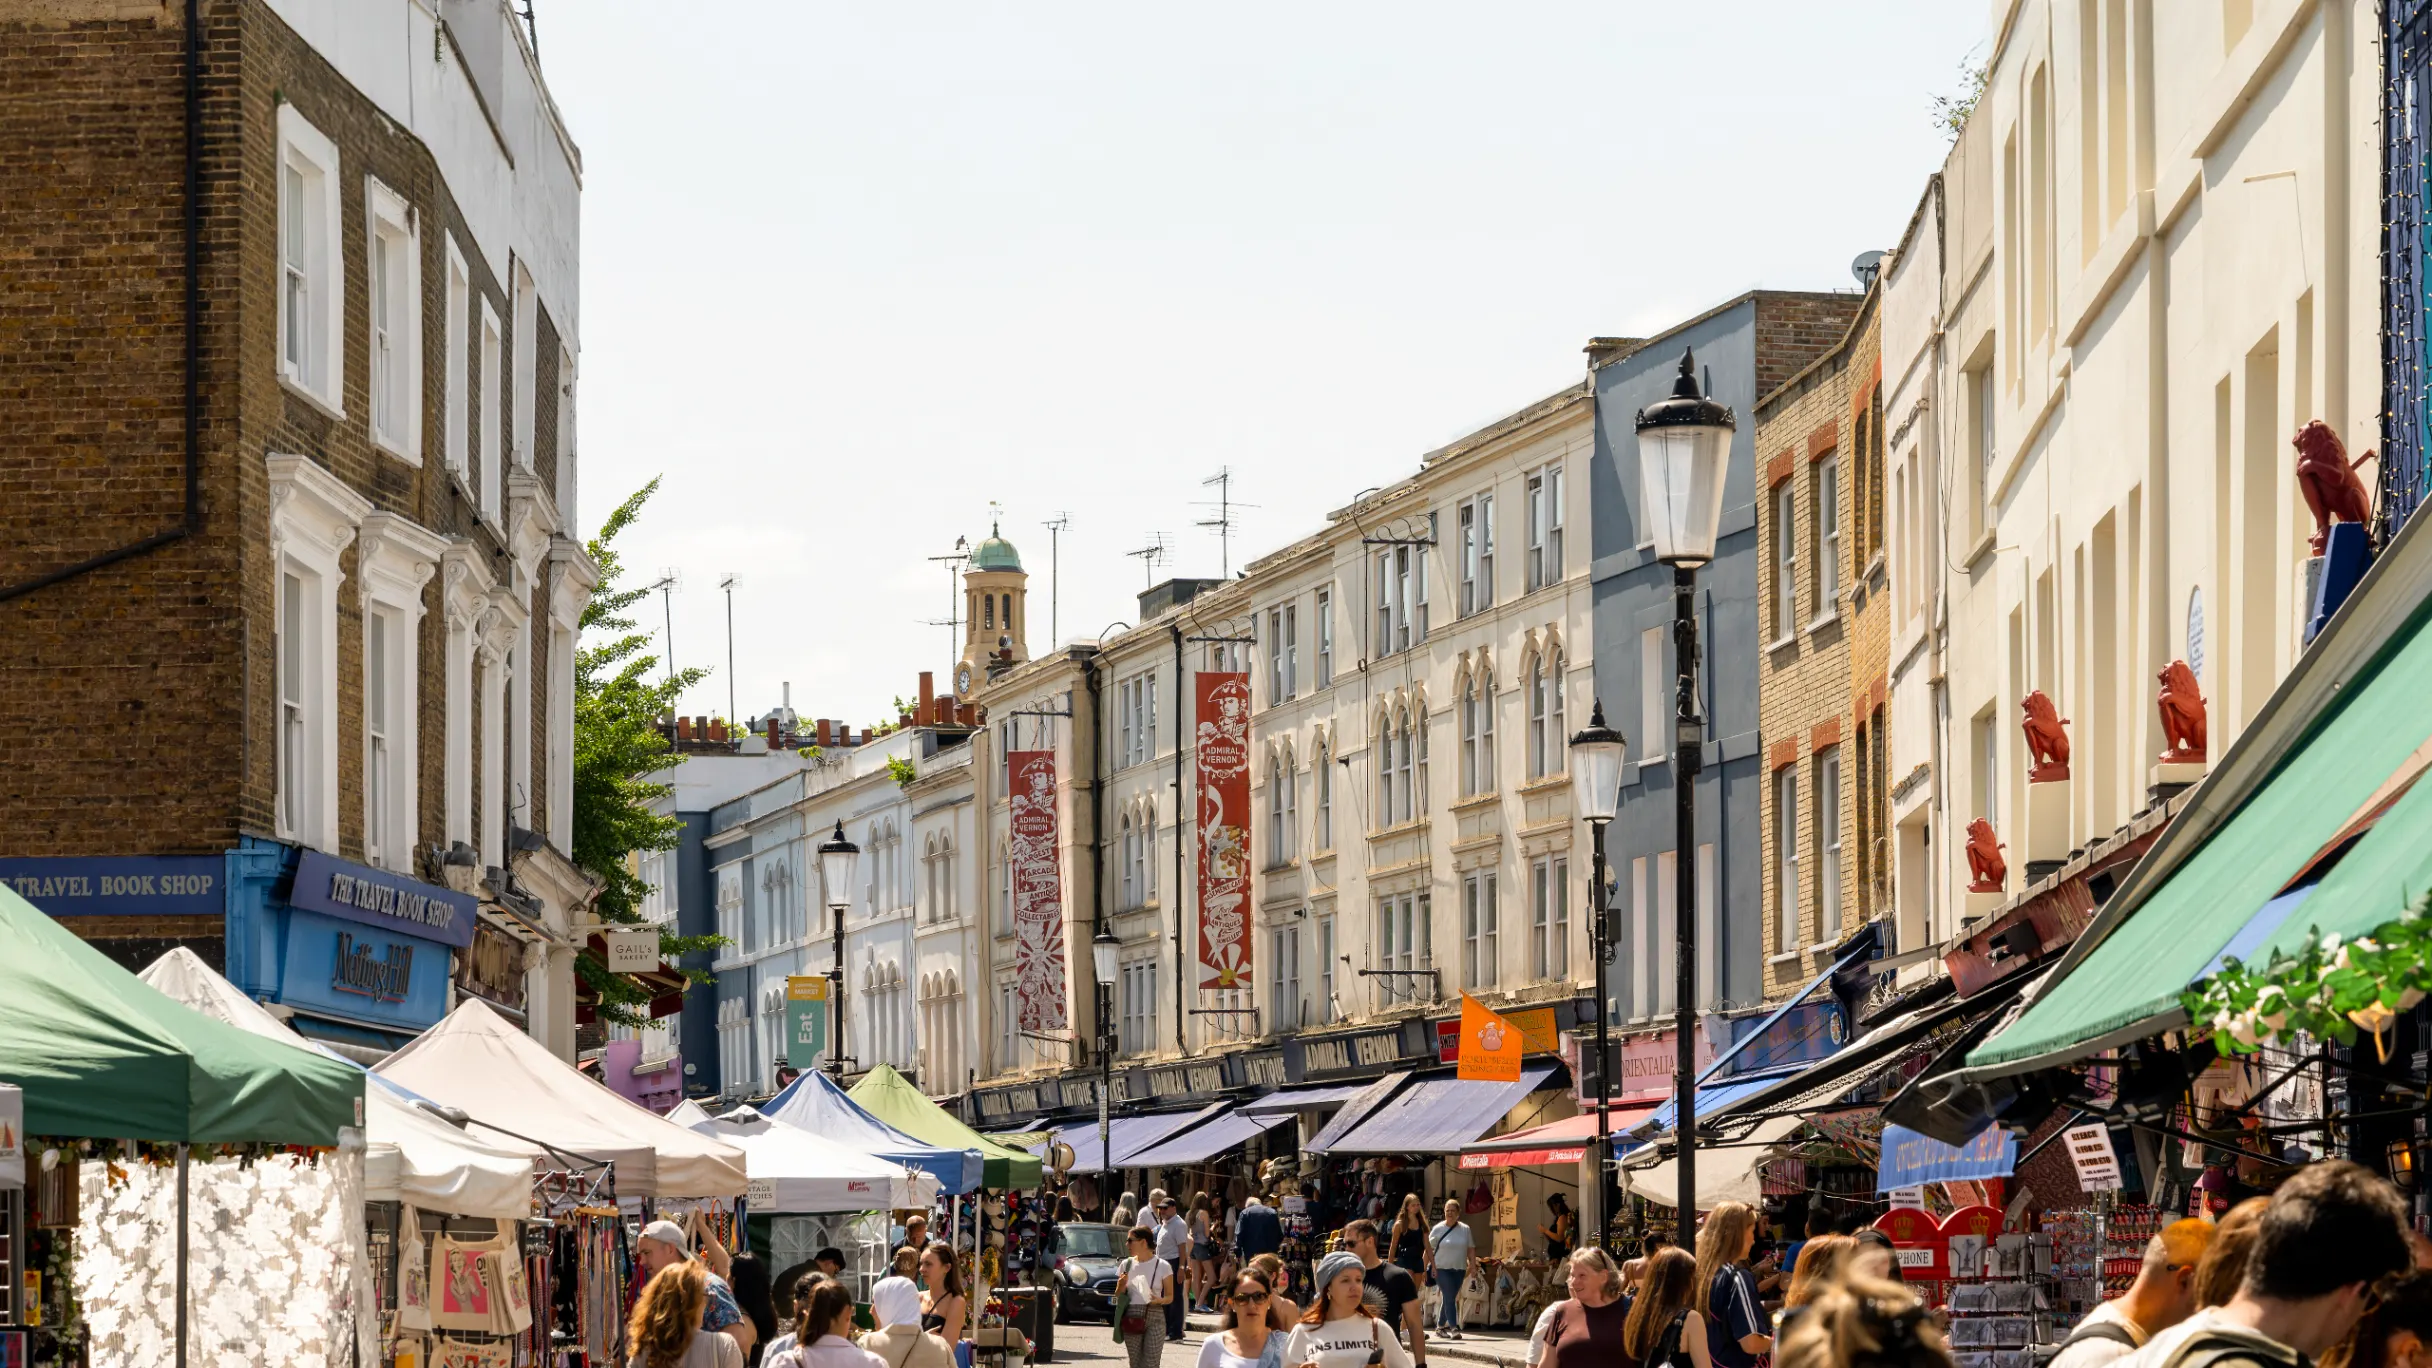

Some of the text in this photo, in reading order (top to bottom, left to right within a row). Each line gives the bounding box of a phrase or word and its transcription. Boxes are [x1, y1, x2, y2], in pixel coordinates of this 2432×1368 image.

[1206, 747, 1240, 755] ADMIRAL
[1206, 756, 1238, 764] VERNON
[1020, 848, 1050, 865] LARGEST
[1027, 867, 1055, 877] ARCADE
[14, 877, 93, 897] TRAVEL
[101, 876, 156, 895] BOOK
[160, 875, 213, 895] SHOP
[331, 873, 454, 928] THE TRAVEL BOOK SHOP
[1017, 909, 1060, 920] COLLECTABLES
[1212, 919, 1241, 928] ANTIQUES
[333, 931, 387, 1003] Notting
[387, 943, 414, 996] Hill
[798, 1012, 813, 1044] Eat
[1305, 1033, 1400, 1071] ADMIRAL VERNON
[1151, 1065, 1223, 1096] ADMIRAL VERNON
[1247, 1057, 1286, 1085] ANTIQUE
[982, 1089, 1039, 1116] ADMIRAL VERNON
[1062, 1081, 1094, 1107] ANTIQUE
[2080, 1130, 2098, 1140] EACH
[1462, 1154, 1489, 1167] Orientalia
[1896, 1250, 1929, 1265] PHONE
